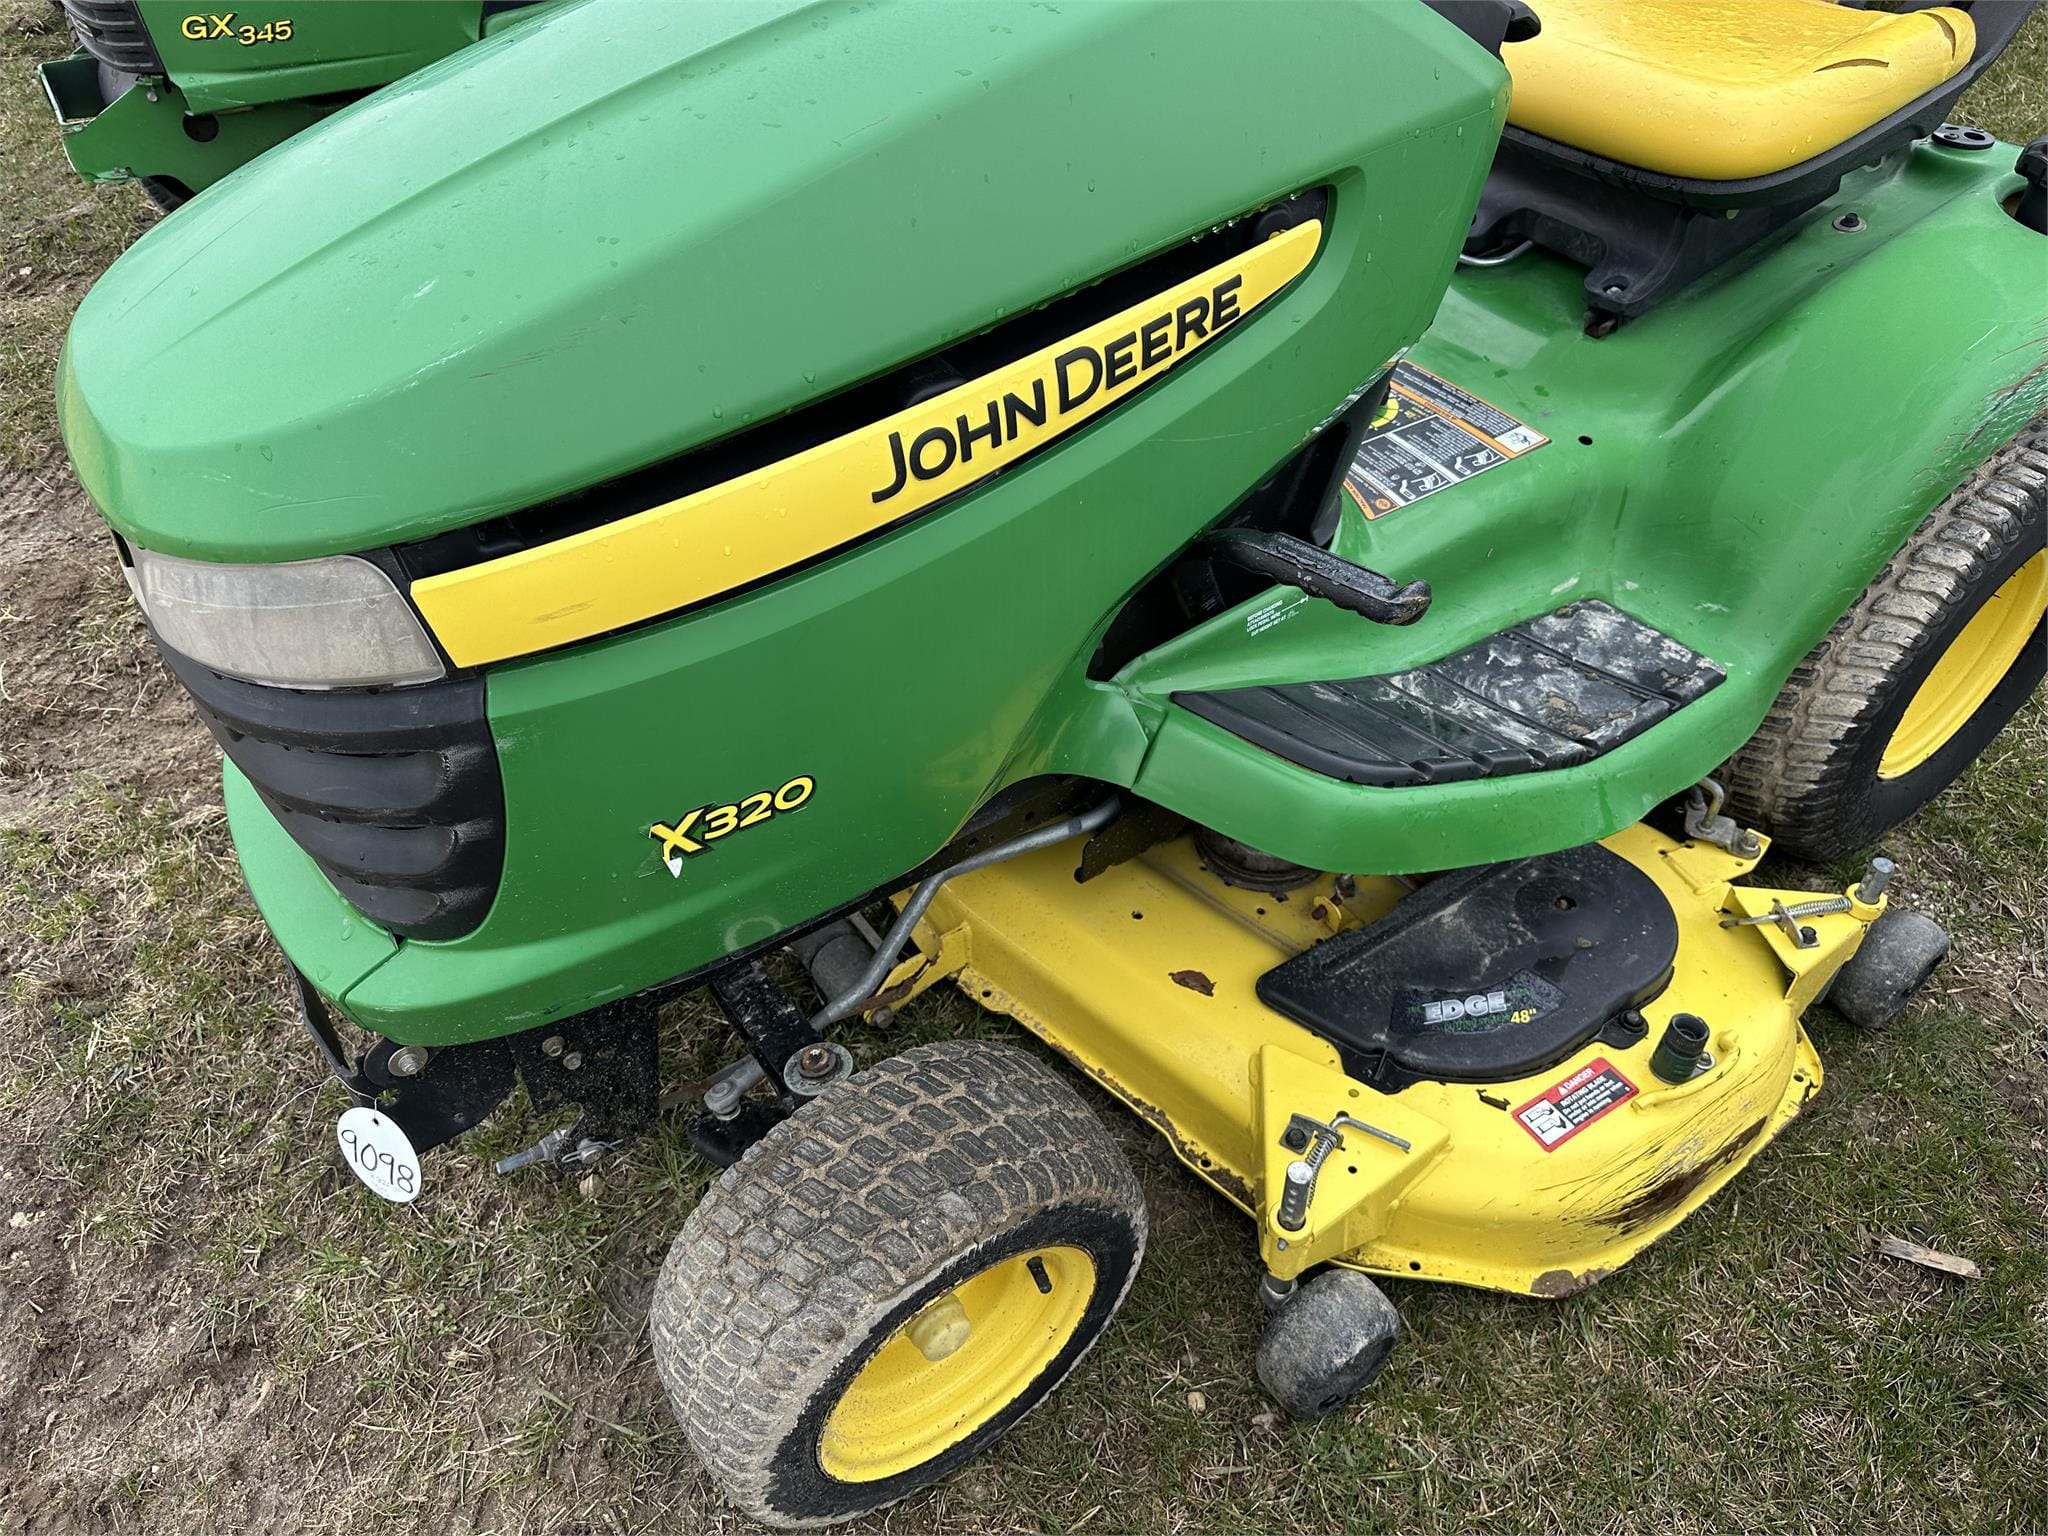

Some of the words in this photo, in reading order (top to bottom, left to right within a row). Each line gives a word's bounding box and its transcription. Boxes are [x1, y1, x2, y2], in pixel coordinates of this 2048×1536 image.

[871, 378, 1047, 503] JOHN
[1055, 273, 1242, 414] DEERE
[649, 775, 816, 866] X320
[1421, 991, 1507, 1025] EDGE
[1510, 1007, 1537, 1024] 48"
[1562, 1067, 1595, 1090] DANGER
[341, 1129, 413, 1193] 9098
